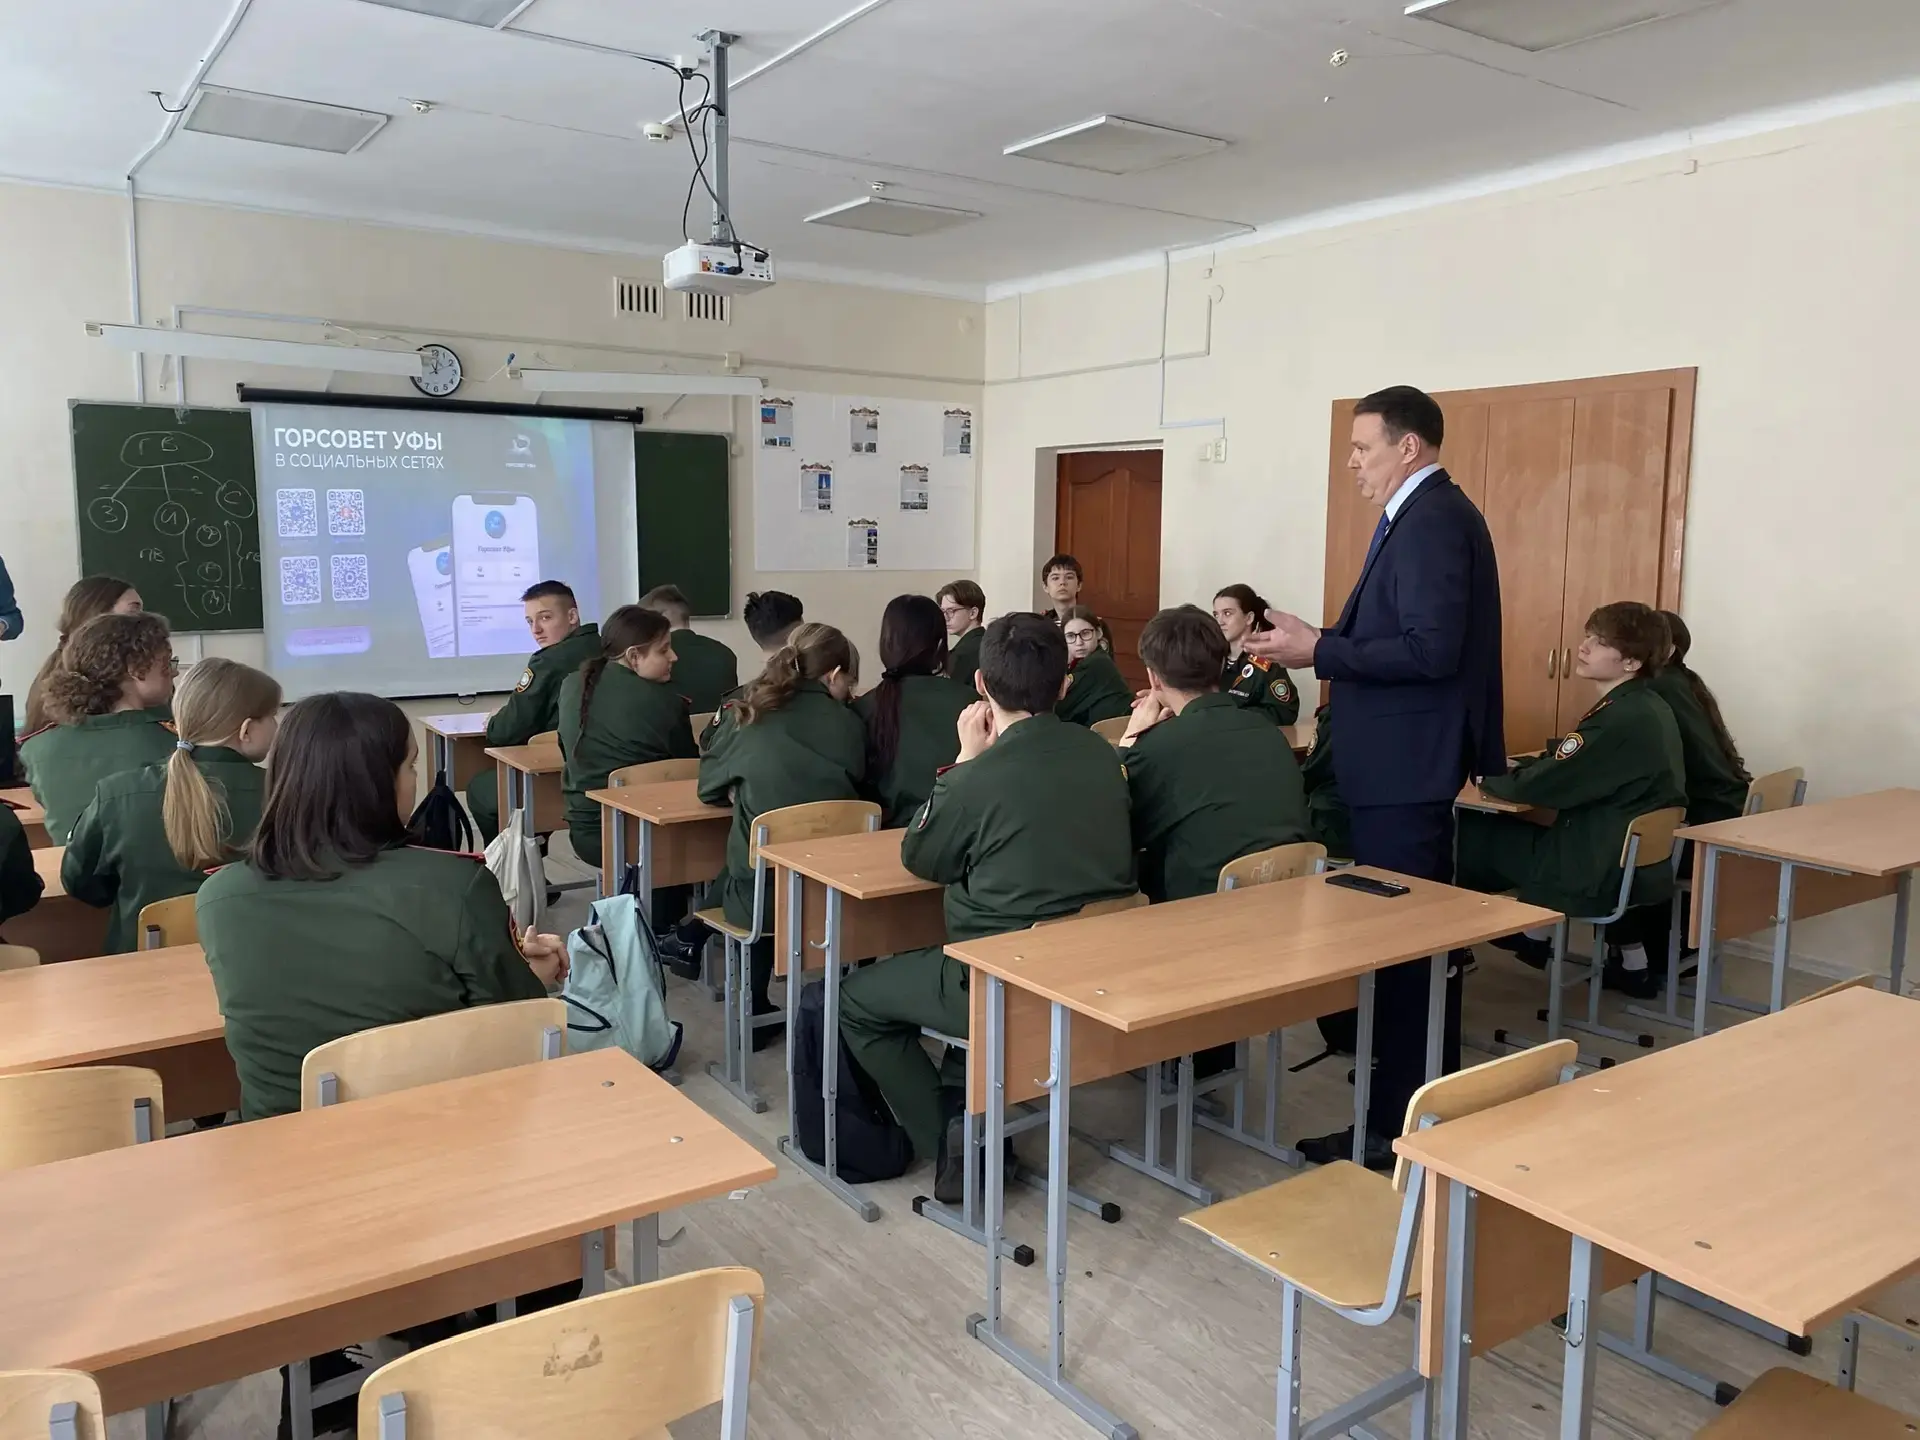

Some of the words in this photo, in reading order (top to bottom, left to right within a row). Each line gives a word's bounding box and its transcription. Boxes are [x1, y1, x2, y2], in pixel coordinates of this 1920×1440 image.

[433, 385, 439, 393] 6
[274, 427, 388, 449] ГОРСОВЕТ
[392, 430, 443, 451] УФЫ
[275, 453, 286, 467] В
[289, 453, 398, 470] СОЦИАЛЬНЫХ
[401, 455, 445, 469] СЕТЯХ
